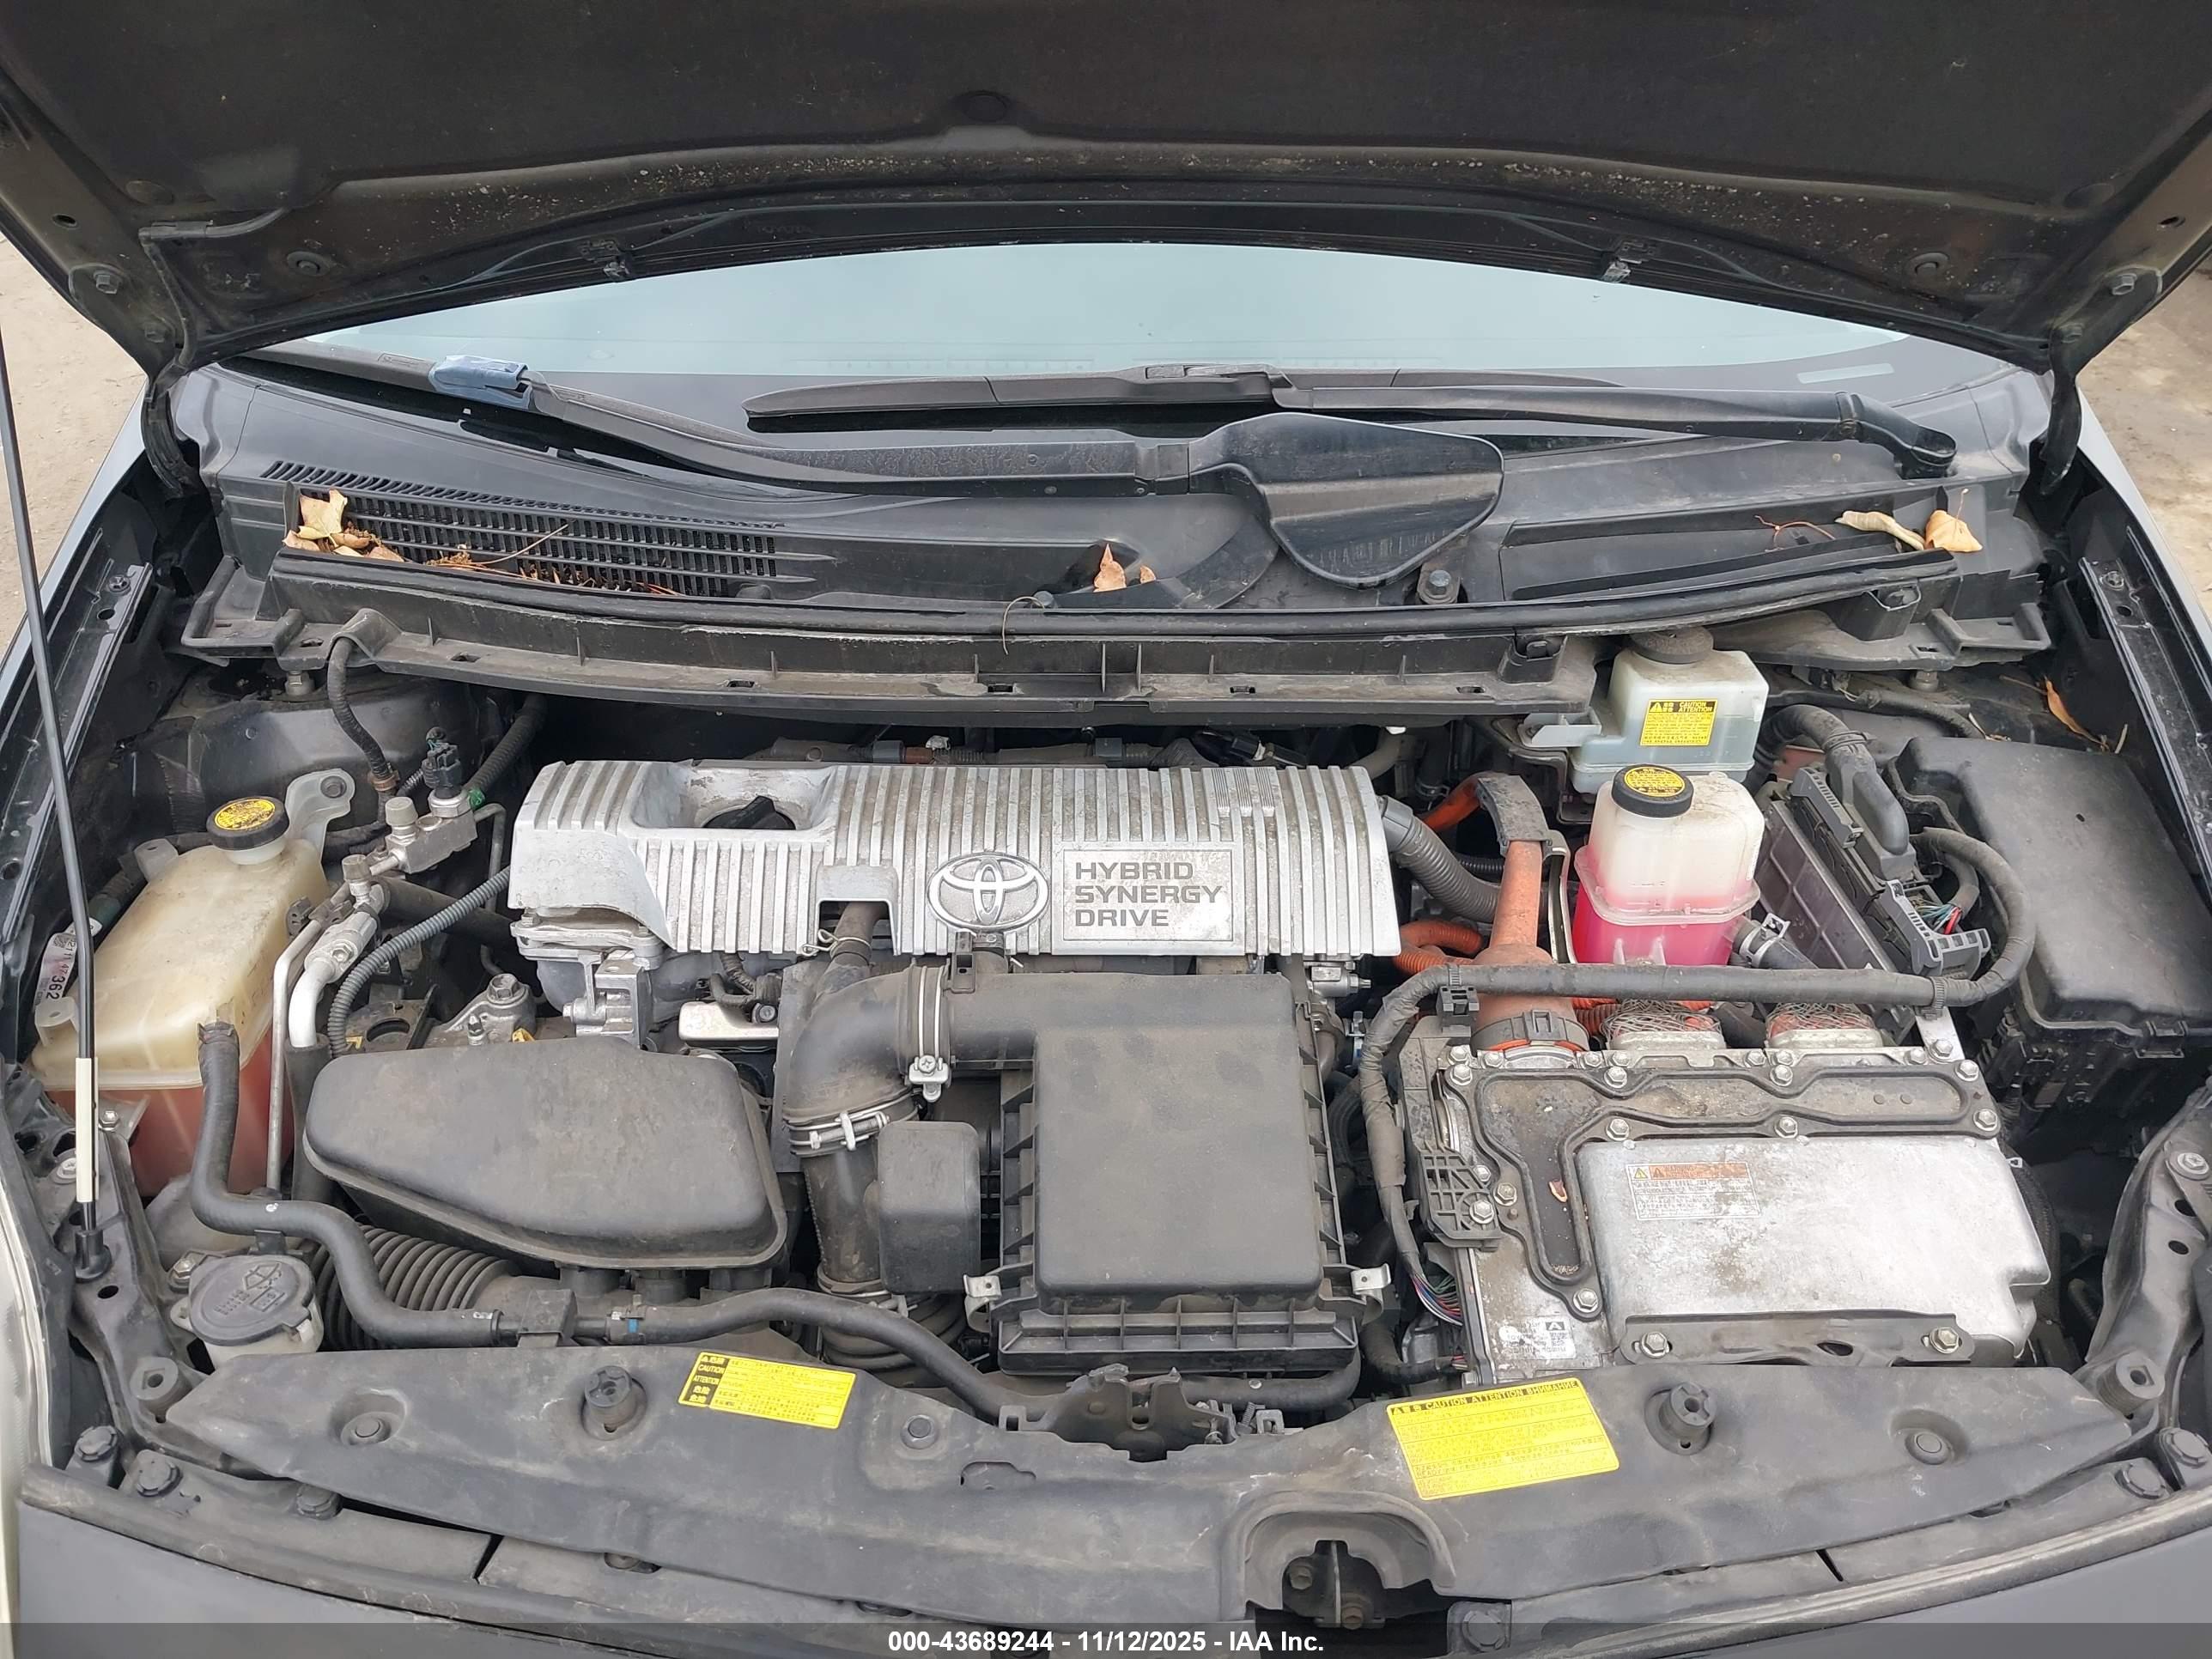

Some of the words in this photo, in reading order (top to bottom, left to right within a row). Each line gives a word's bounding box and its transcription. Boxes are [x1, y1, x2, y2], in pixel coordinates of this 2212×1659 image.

[1075, 862, 1194, 880] HYBRID
[1075, 885, 1223, 903] SYNERGY
[1075, 908, 1170, 927] DRIVE
[698, 1364, 726, 1374] CAUTION
[1426, 1397, 1468, 1411] CAUTION
[1471, 1389, 1522, 1403] ATTENTION
